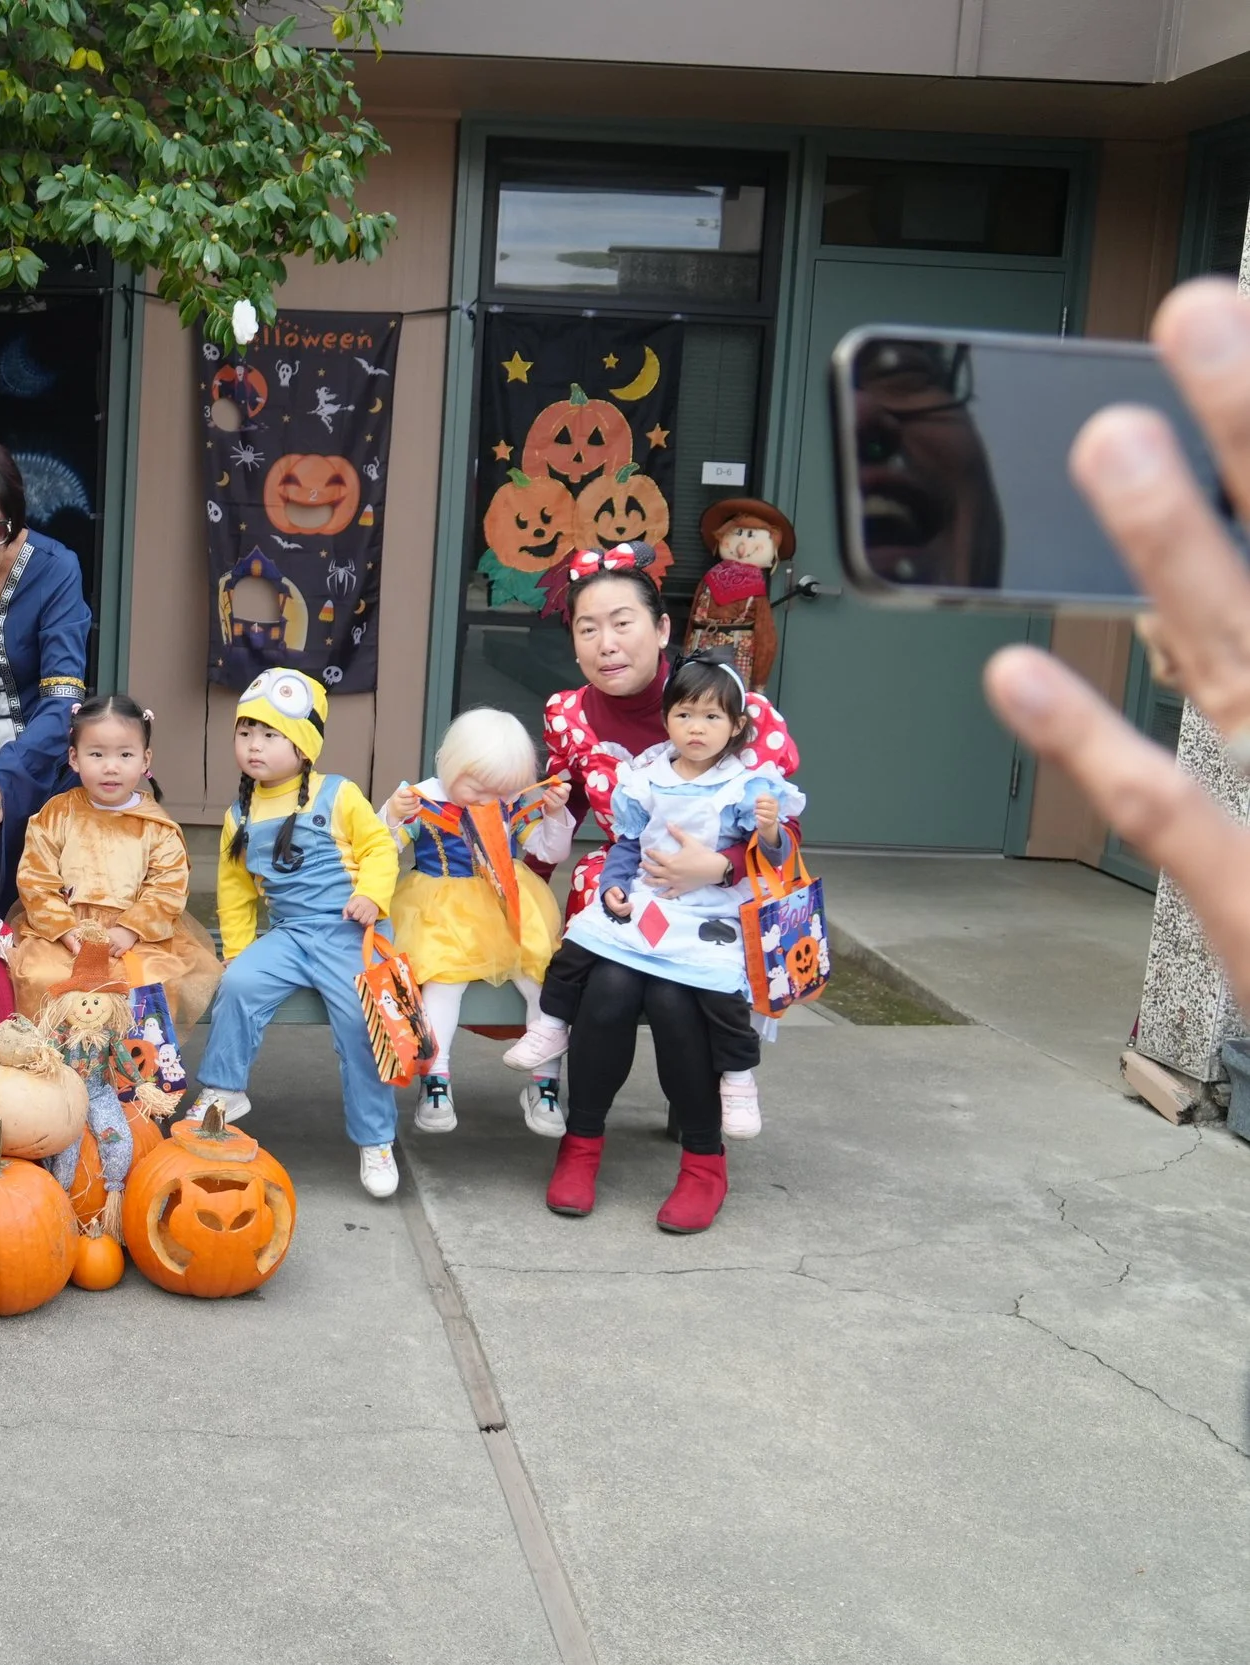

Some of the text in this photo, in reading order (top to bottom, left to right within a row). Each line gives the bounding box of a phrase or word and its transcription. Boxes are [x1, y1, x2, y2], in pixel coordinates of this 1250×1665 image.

[247, 324, 373, 348] lloween
[204, 405, 211, 418] 3
[716, 467, 732, 476] D-6
[310, 489, 318, 502] 2
[778, 894, 815, 937] Boo!
